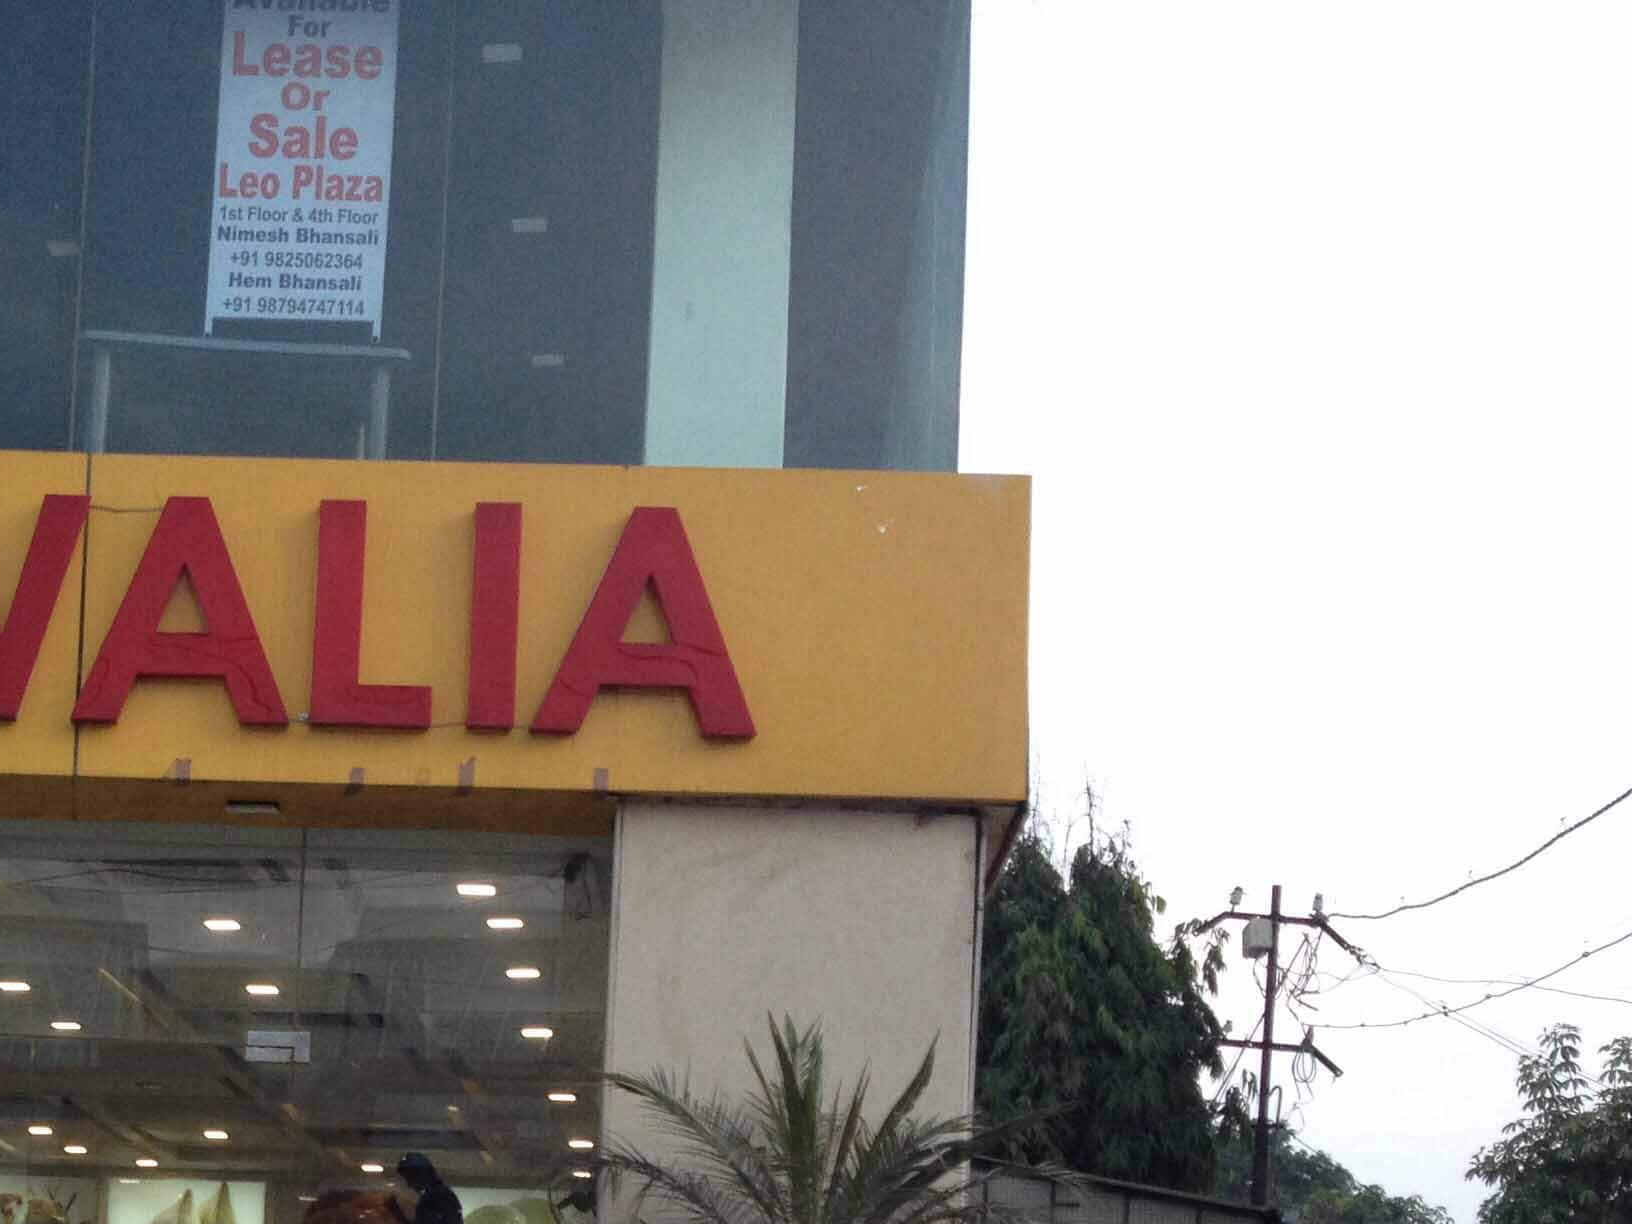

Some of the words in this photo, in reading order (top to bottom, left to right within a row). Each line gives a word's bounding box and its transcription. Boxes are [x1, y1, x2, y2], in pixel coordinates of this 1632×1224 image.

[288, 15, 332, 37] For
[233, 31, 384, 80] Lease
[281, 81, 330, 111] Or
[248, 113, 359, 160] Sale
[218, 163, 280, 199] Leo
[292, 165, 383, 202] Plaza
[220, 206, 243, 221] 1st
[248, 207, 288, 223] Floor
[292, 208, 303, 223] &
[309, 208, 333, 223] 4th
[338, 209, 379, 225] Floor
[218, 226, 289, 243] Nimesh
[296, 229, 379, 245] Bhansali
[231, 251, 258, 266] +91
[229, 272, 272, 289] Hem
[279, 274, 361, 291] Bhansali
[224, 298, 250, 313] +91
